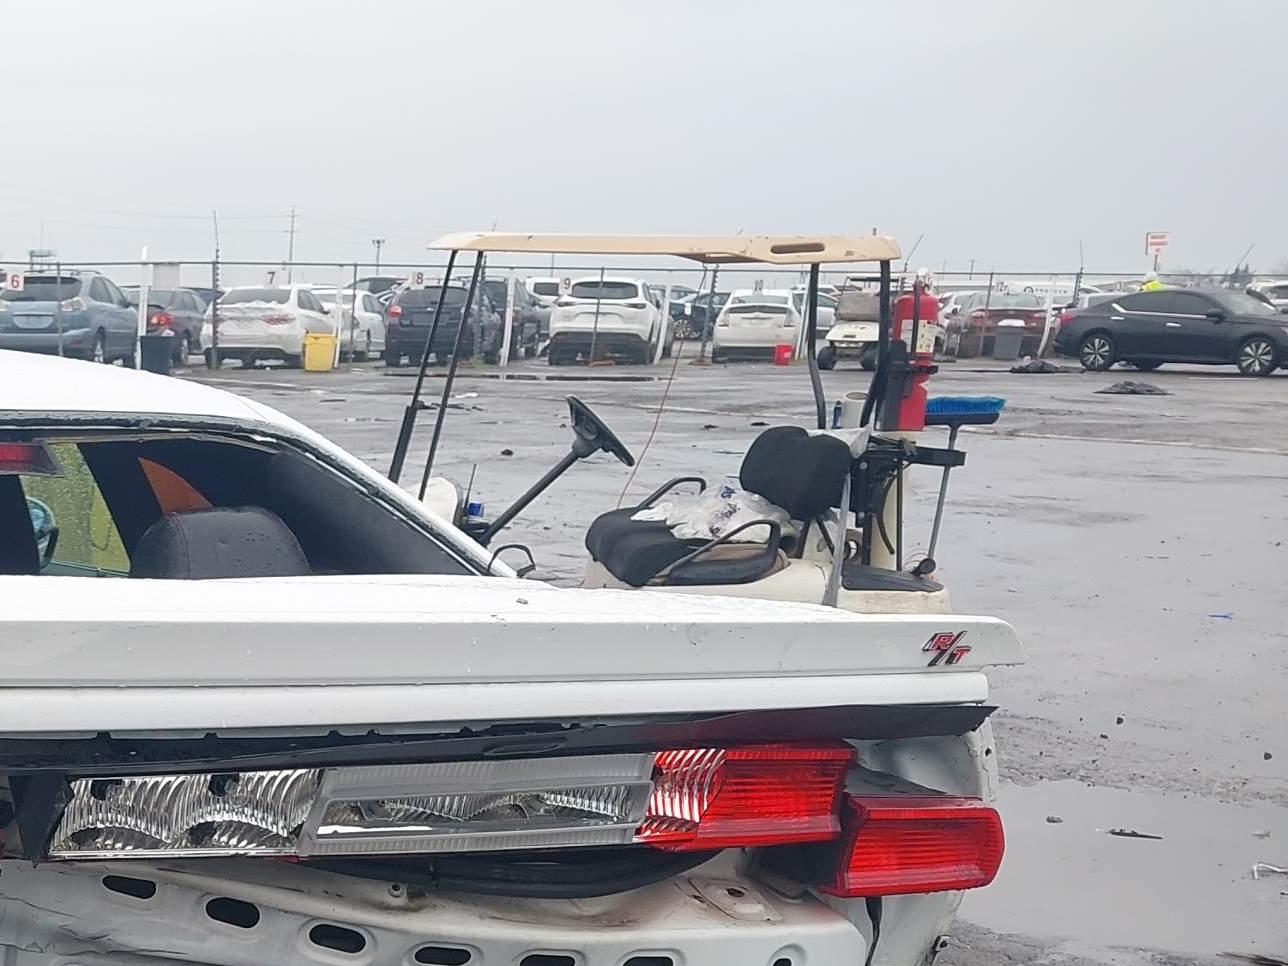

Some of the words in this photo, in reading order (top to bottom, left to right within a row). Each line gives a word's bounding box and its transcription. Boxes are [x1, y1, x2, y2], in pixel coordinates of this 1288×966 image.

[11, 274, 20, 289] 6
[267, 271, 276, 285] 7
[416, 272, 424, 285] 8
[564, 278, 571, 290] 9
[922, 630, 972, 667] R/T
